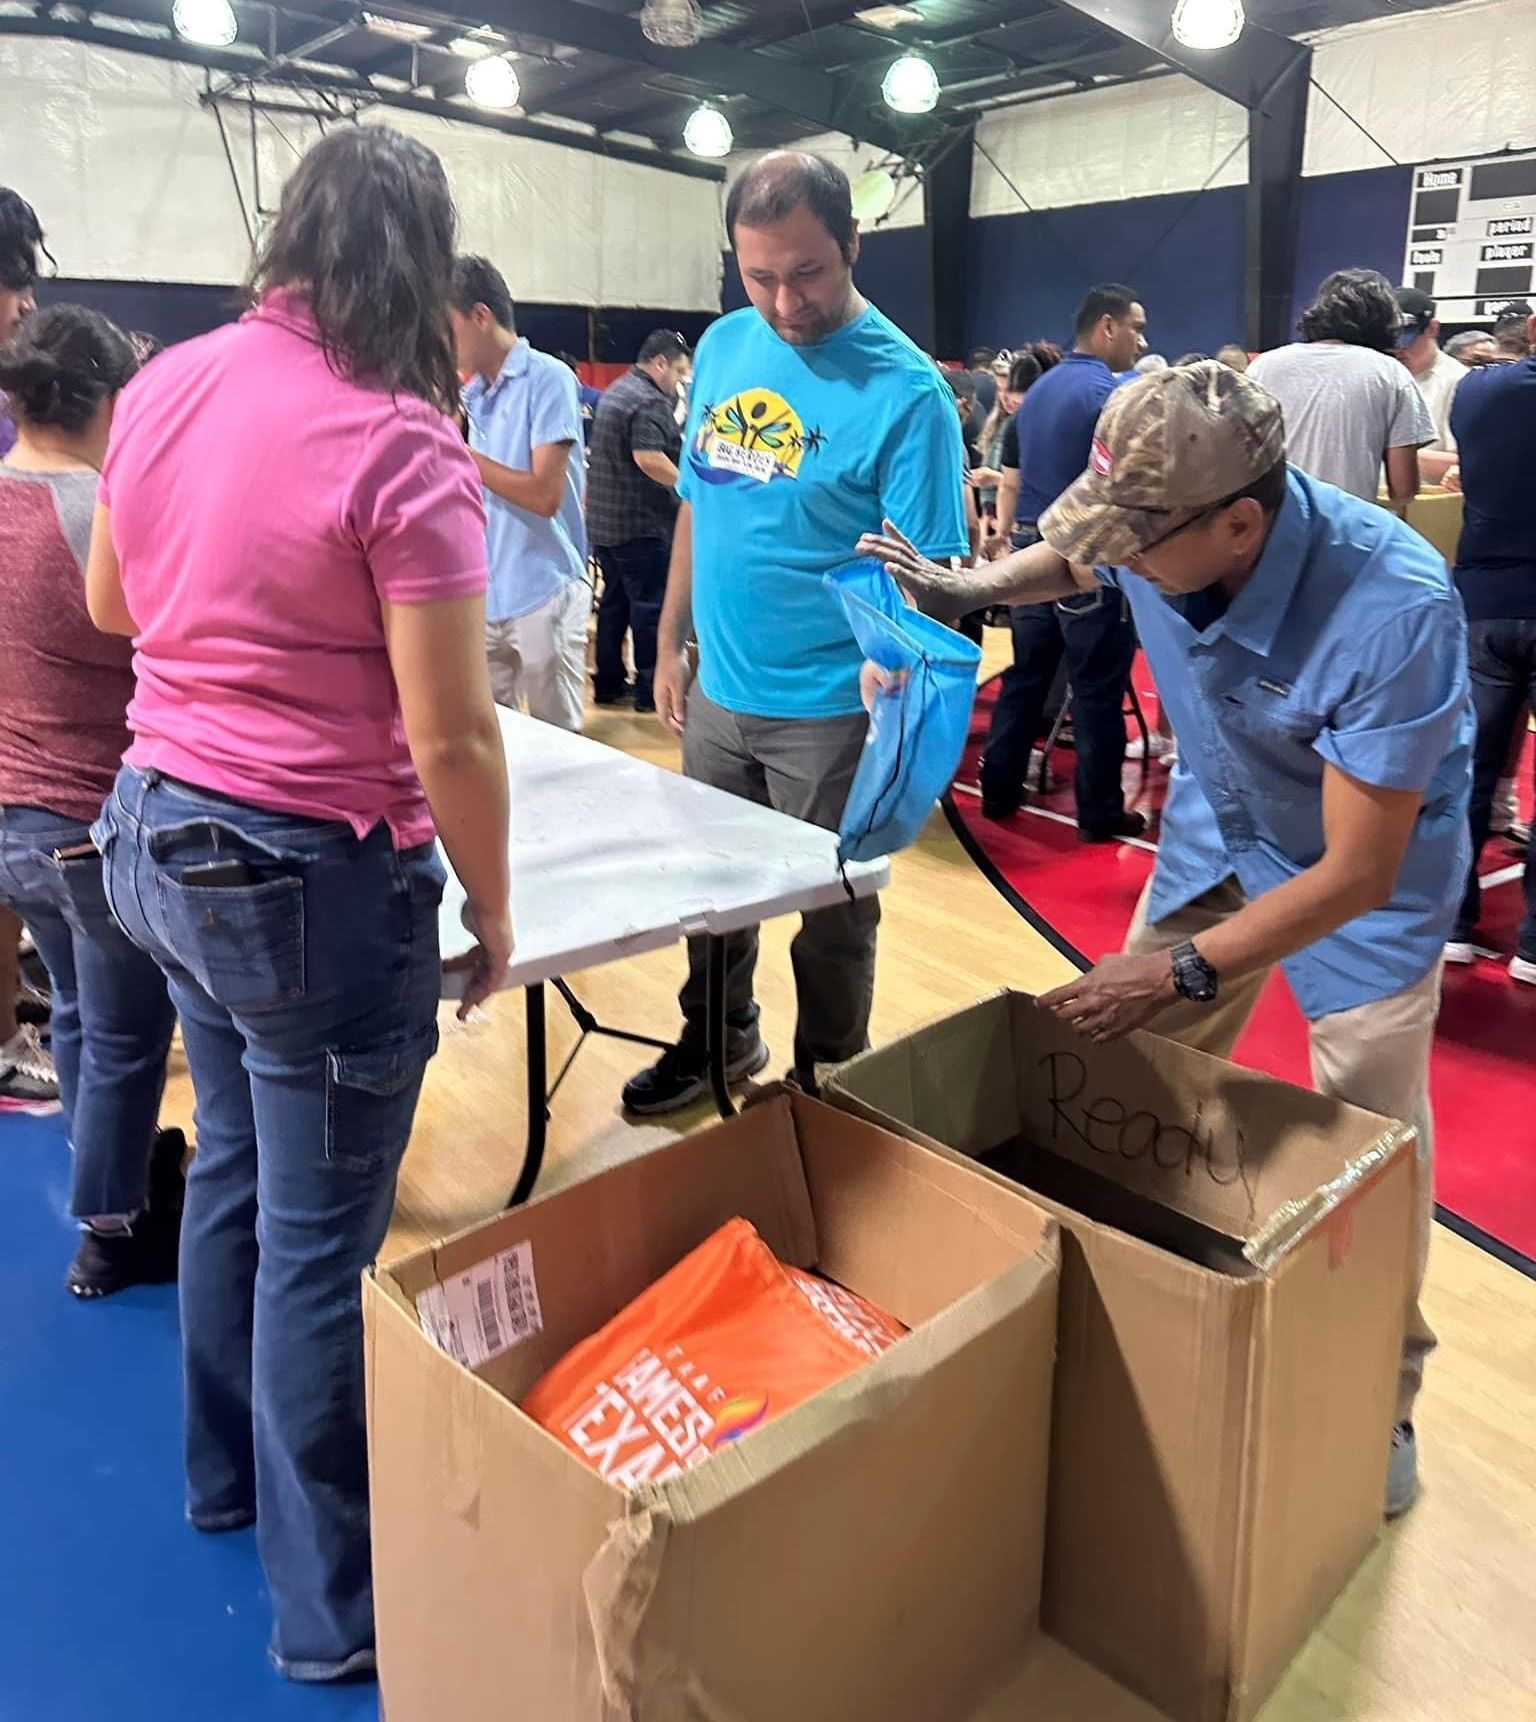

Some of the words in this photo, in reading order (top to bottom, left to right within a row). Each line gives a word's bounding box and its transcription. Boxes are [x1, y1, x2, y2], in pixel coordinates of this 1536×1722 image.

[1489, 217, 1531, 236] period
[1484, 245, 1528, 261] player
[1038, 1051, 1261, 1221] Ready
